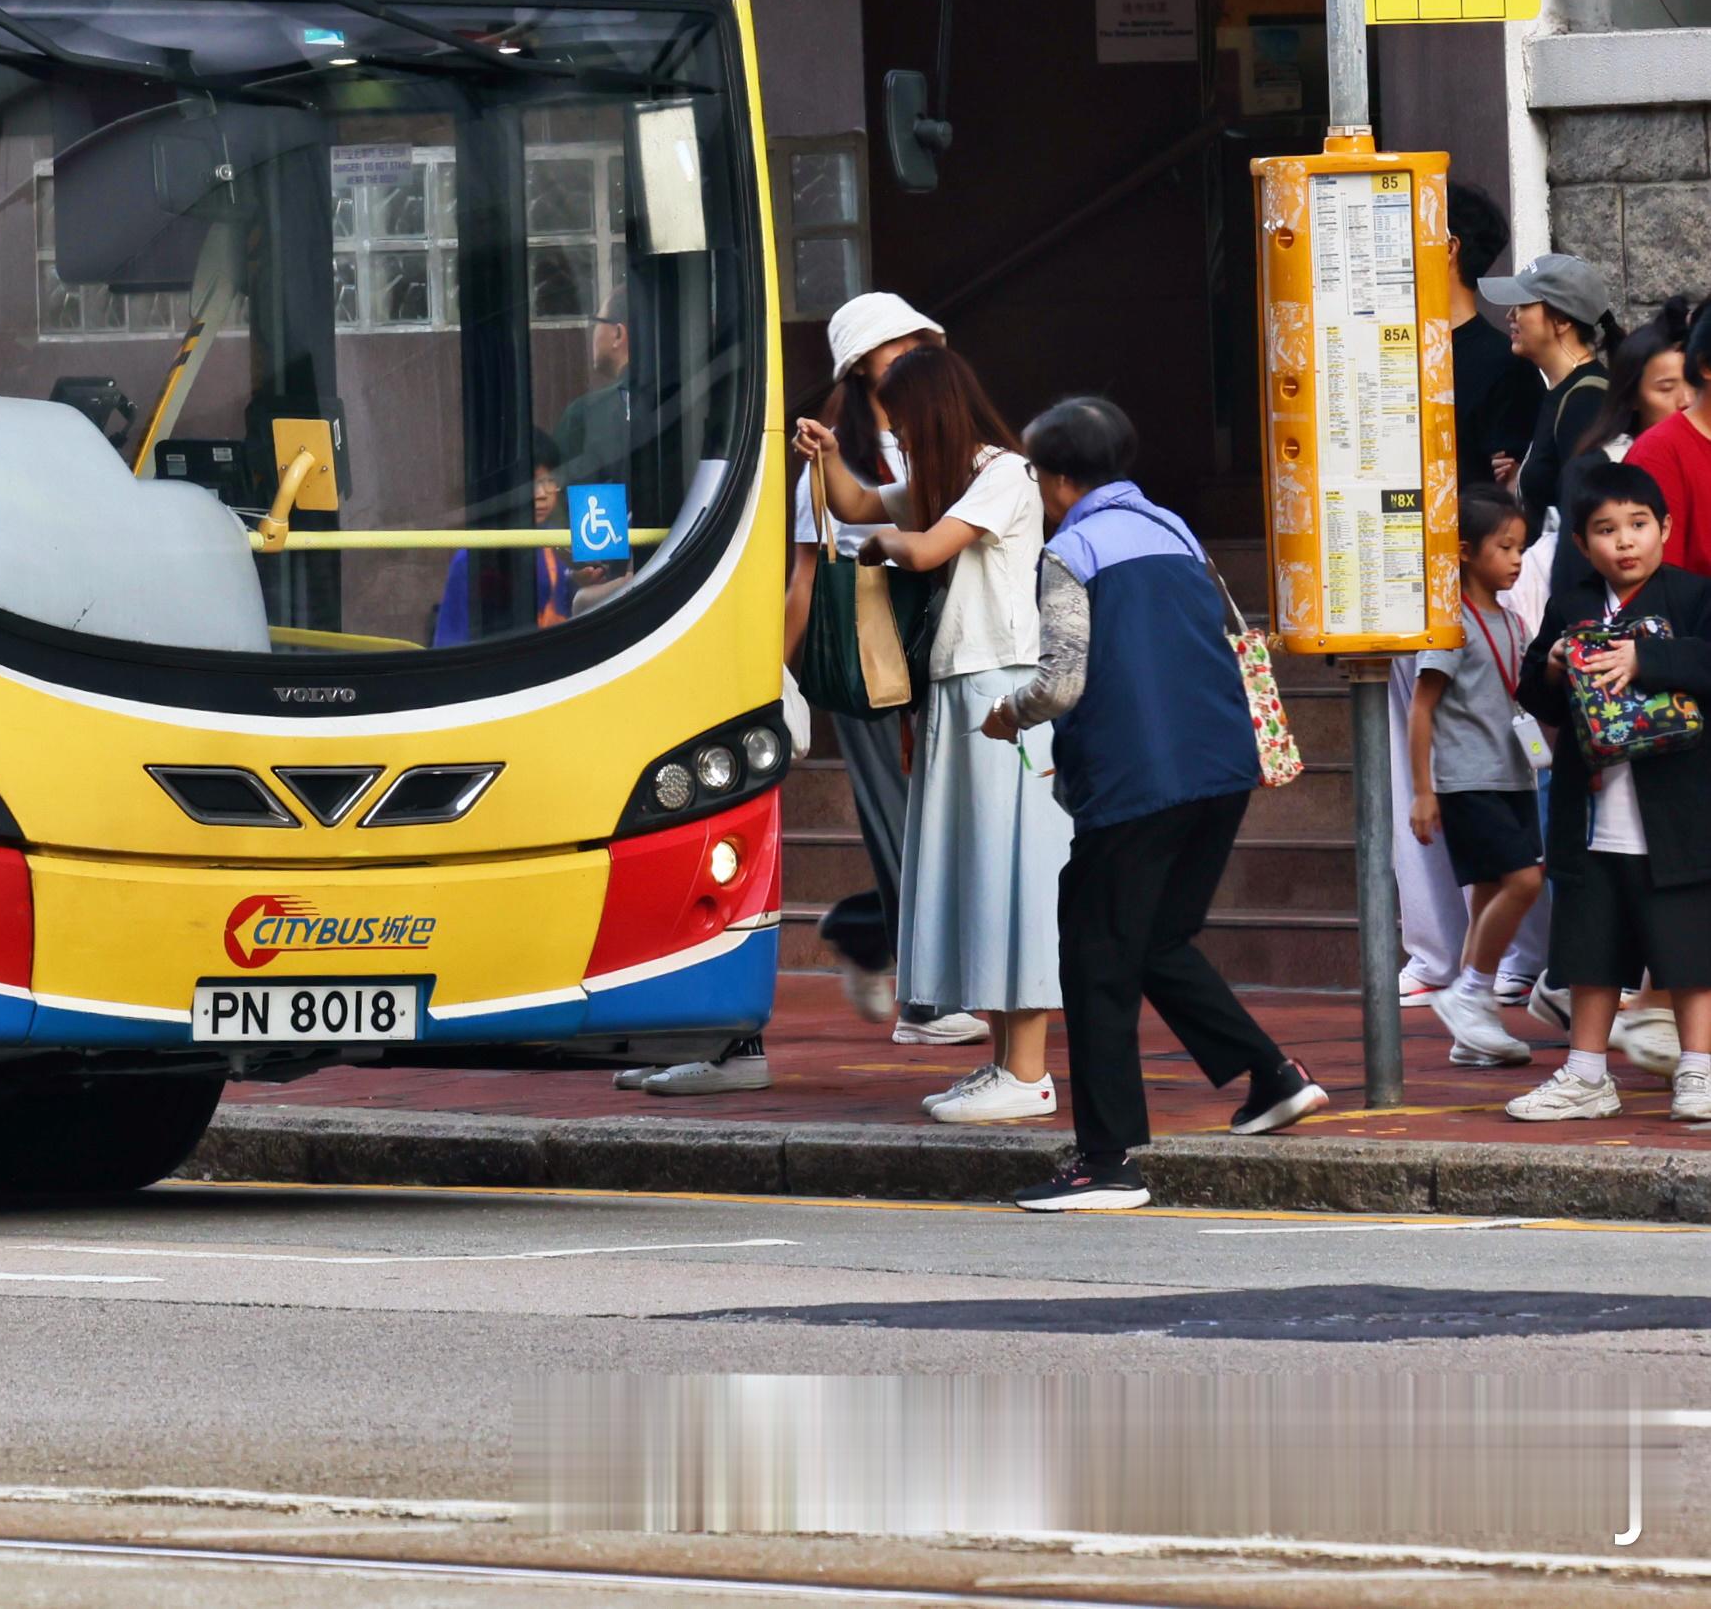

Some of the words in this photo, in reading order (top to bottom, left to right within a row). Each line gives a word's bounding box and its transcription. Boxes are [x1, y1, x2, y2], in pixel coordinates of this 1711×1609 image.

[1381, 176, 1398, 189] 85
[1384, 329, 1410, 341] 85A
[273, 687, 356, 702] VOLVO
[253, 917, 379, 945] CITYBUS
[378, 914, 437, 944] 城巴
[212, 992, 269, 1035] PN
[290, 990, 396, 1033] 8018
